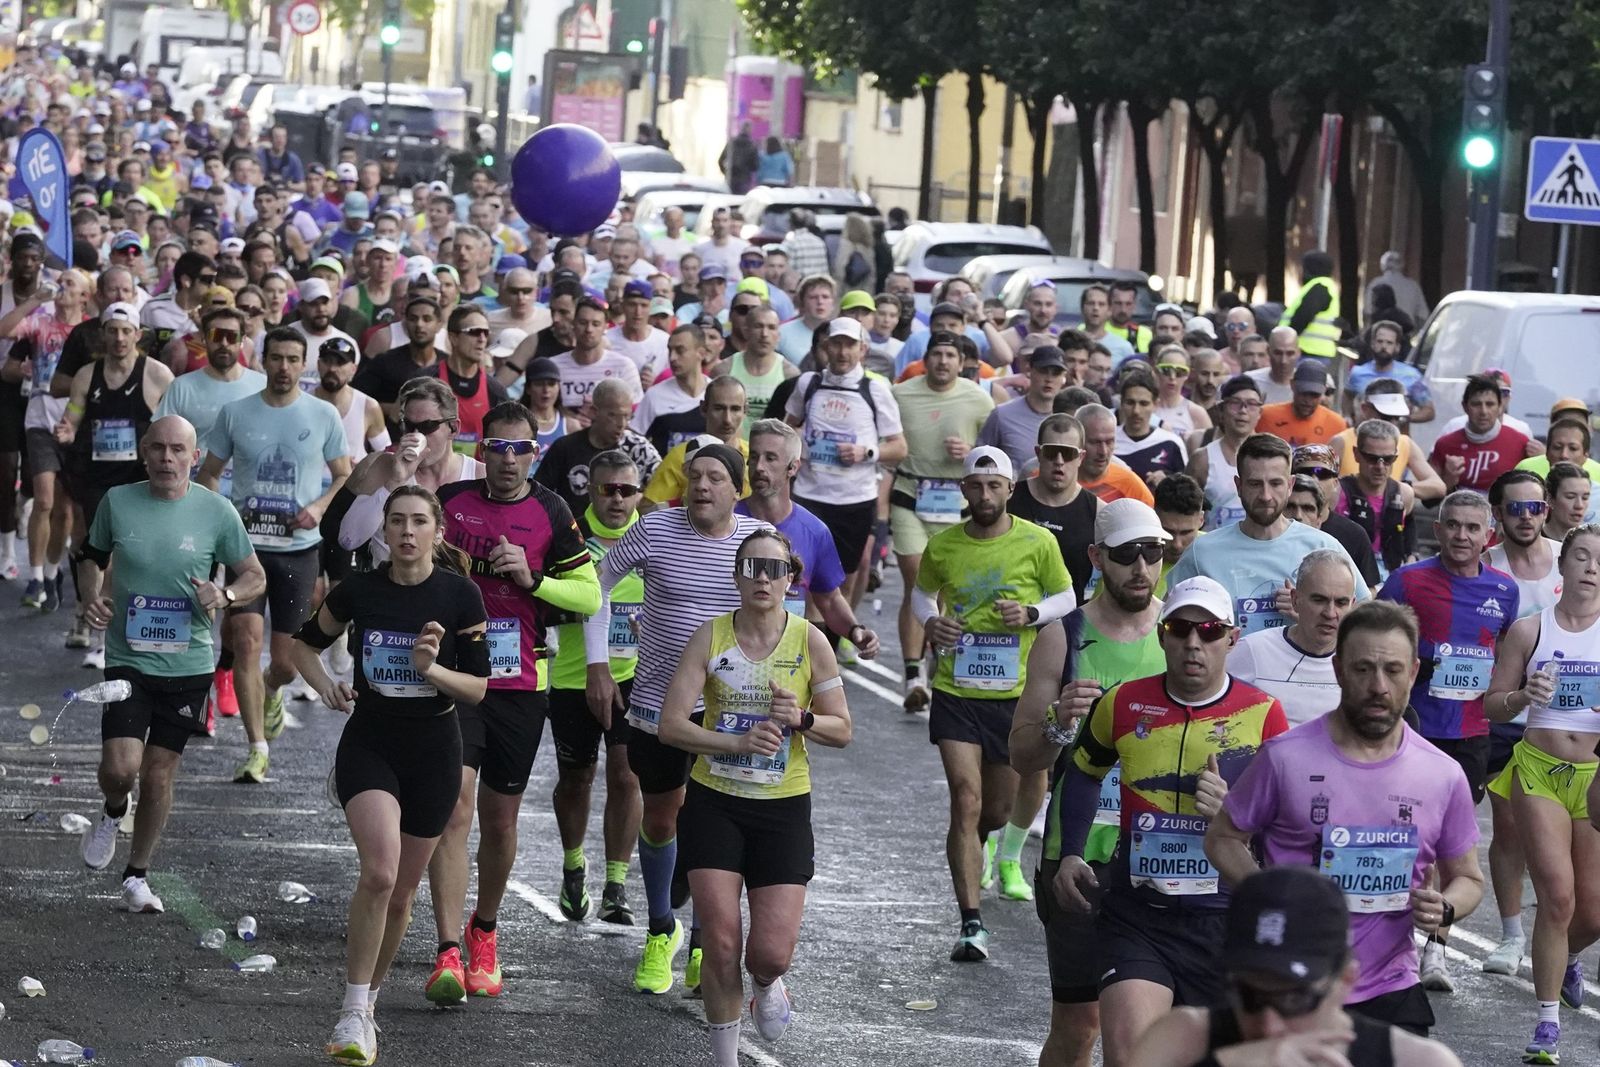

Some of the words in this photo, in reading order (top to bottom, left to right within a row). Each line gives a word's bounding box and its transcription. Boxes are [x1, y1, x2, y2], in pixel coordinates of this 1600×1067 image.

[260, 500, 290, 509] ZURICH
[248, 523, 286, 535] JABATO
[150, 600, 185, 608] ZURICH
[150, 616, 168, 624] 7687
[140, 626, 176, 640] CHRIS
[1456, 647, 1487, 656] ZURICH
[388, 656, 409, 666] 6253
[968, 664, 1006, 676] COSTA
[1456, 664, 1472, 672] 6265
[1560, 664, 1598, 673] ZURICH
[1444, 674, 1469, 687] LUIS
[1472, 676, 1479, 688] S
[1561, 684, 1580, 692] 7127
[1559, 695, 1584, 707] BEA
[1161, 818, 1209, 831] ZURICH
[1356, 832, 1408, 843] ZURICH
[1161, 842, 1187, 853] 8800
[1140, 857, 1209, 875] ROMERO
[1356, 857, 1384, 868] 7873
